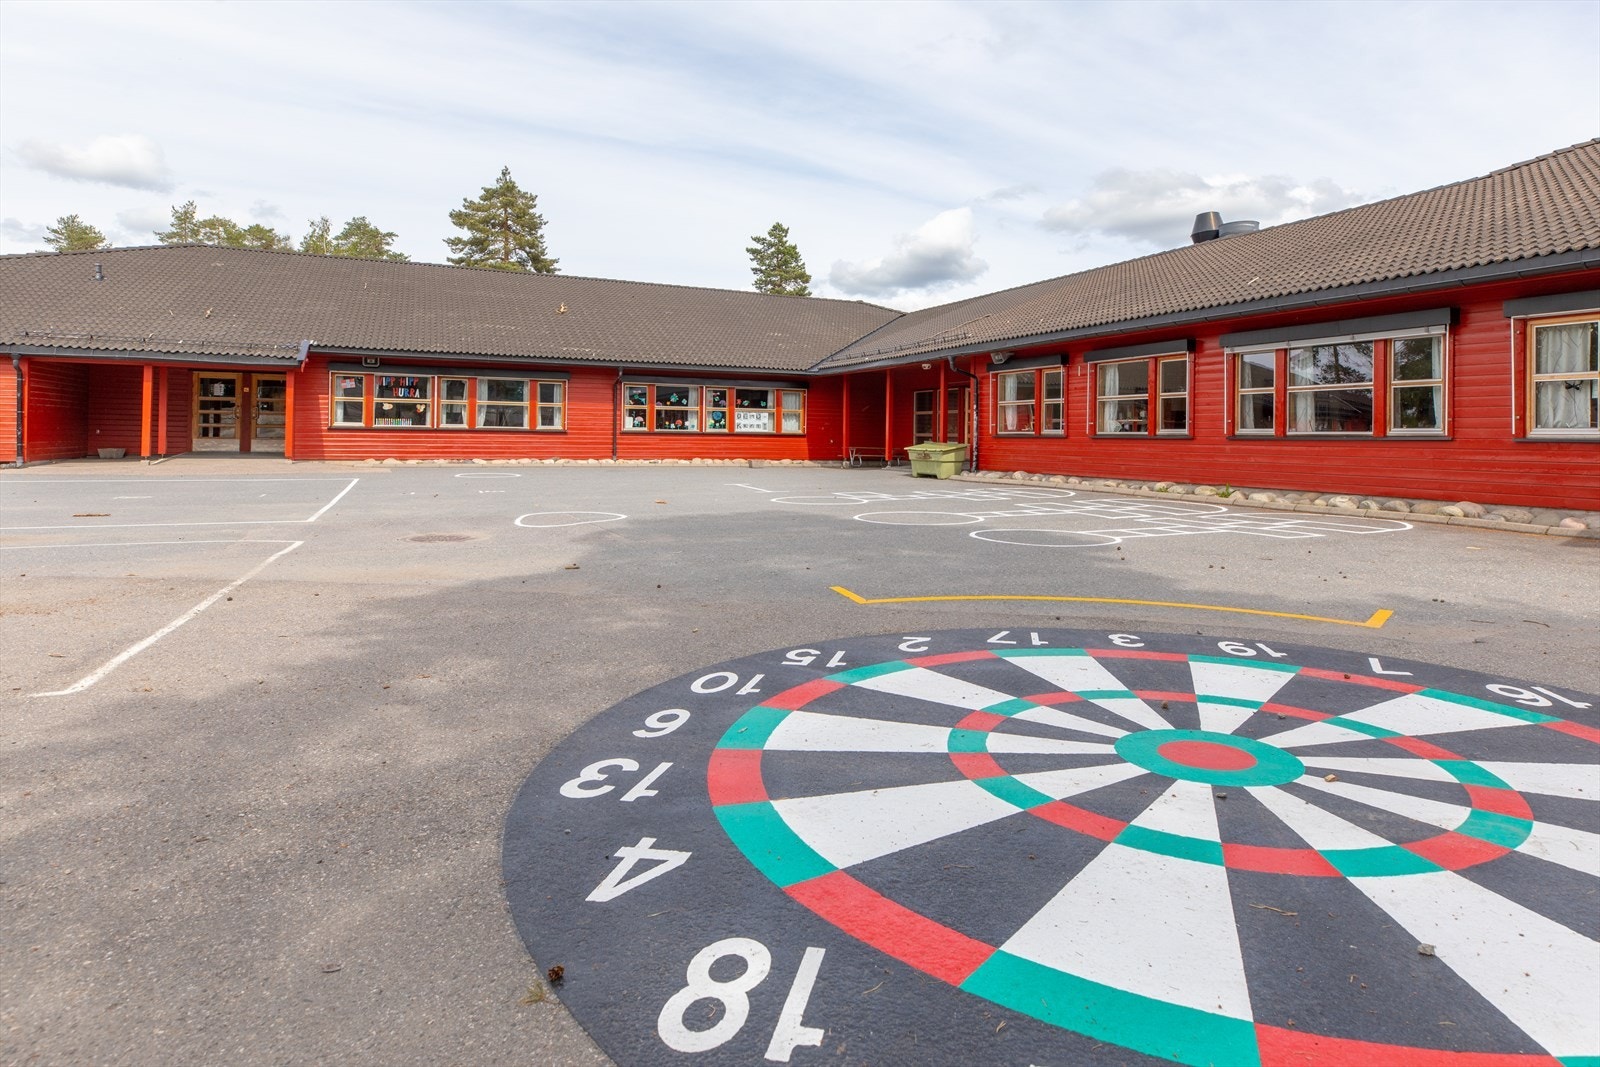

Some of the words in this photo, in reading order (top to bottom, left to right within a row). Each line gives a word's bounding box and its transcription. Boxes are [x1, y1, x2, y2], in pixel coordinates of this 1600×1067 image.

[377, 376, 395, 386] HIPP
[400, 376, 419, 386] HIPP
[393, 387, 420, 398] HURRA
[897, 635, 932, 653] 2
[987, 631, 1049, 646] 17
[1107, 633, 1145, 648] 3
[781, 648, 848, 668] 15
[1217, 640, 1288, 658] 19
[1368, 657, 1414, 676] 7
[690, 671, 766, 696] 10
[1485, 683, 1593, 710] 16
[559, 757, 675, 803] 13
[584, 836, 693, 903] 4
[656, 936, 827, 1063] 18
